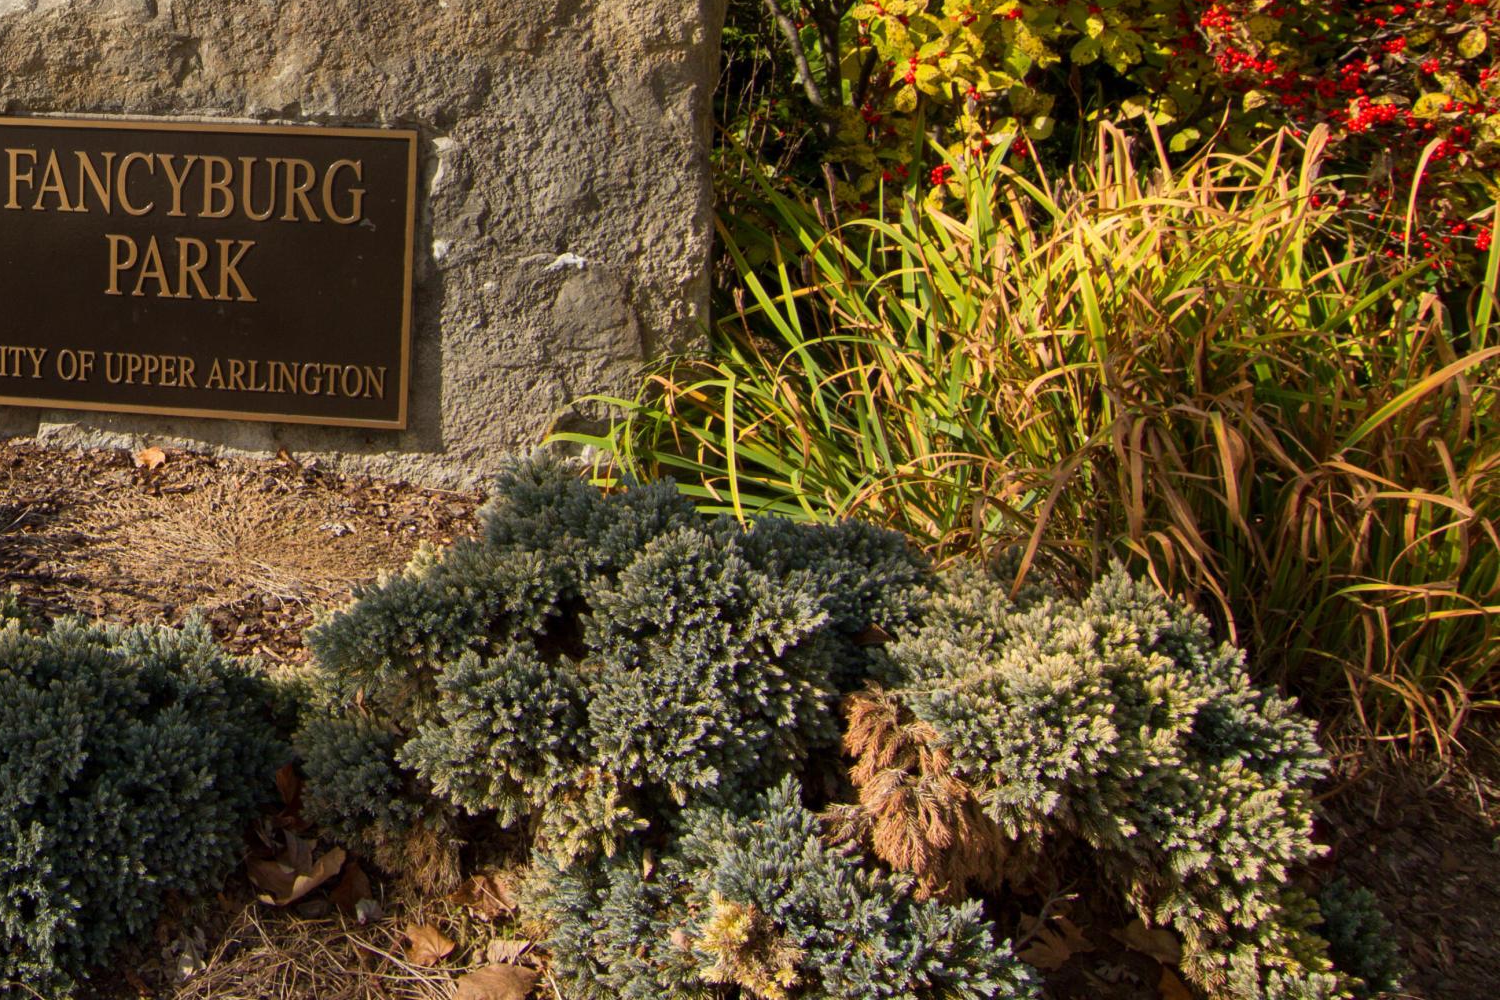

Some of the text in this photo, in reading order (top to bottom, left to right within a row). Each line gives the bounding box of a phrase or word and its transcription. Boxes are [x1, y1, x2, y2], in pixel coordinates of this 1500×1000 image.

[3, 147, 367, 225] FANCYBURG
[104, 233, 258, 302] PARK
[56, 348, 96, 382] OF
[103, 351, 198, 389] UPPER
[205, 358, 388, 400] ARLINGTON
